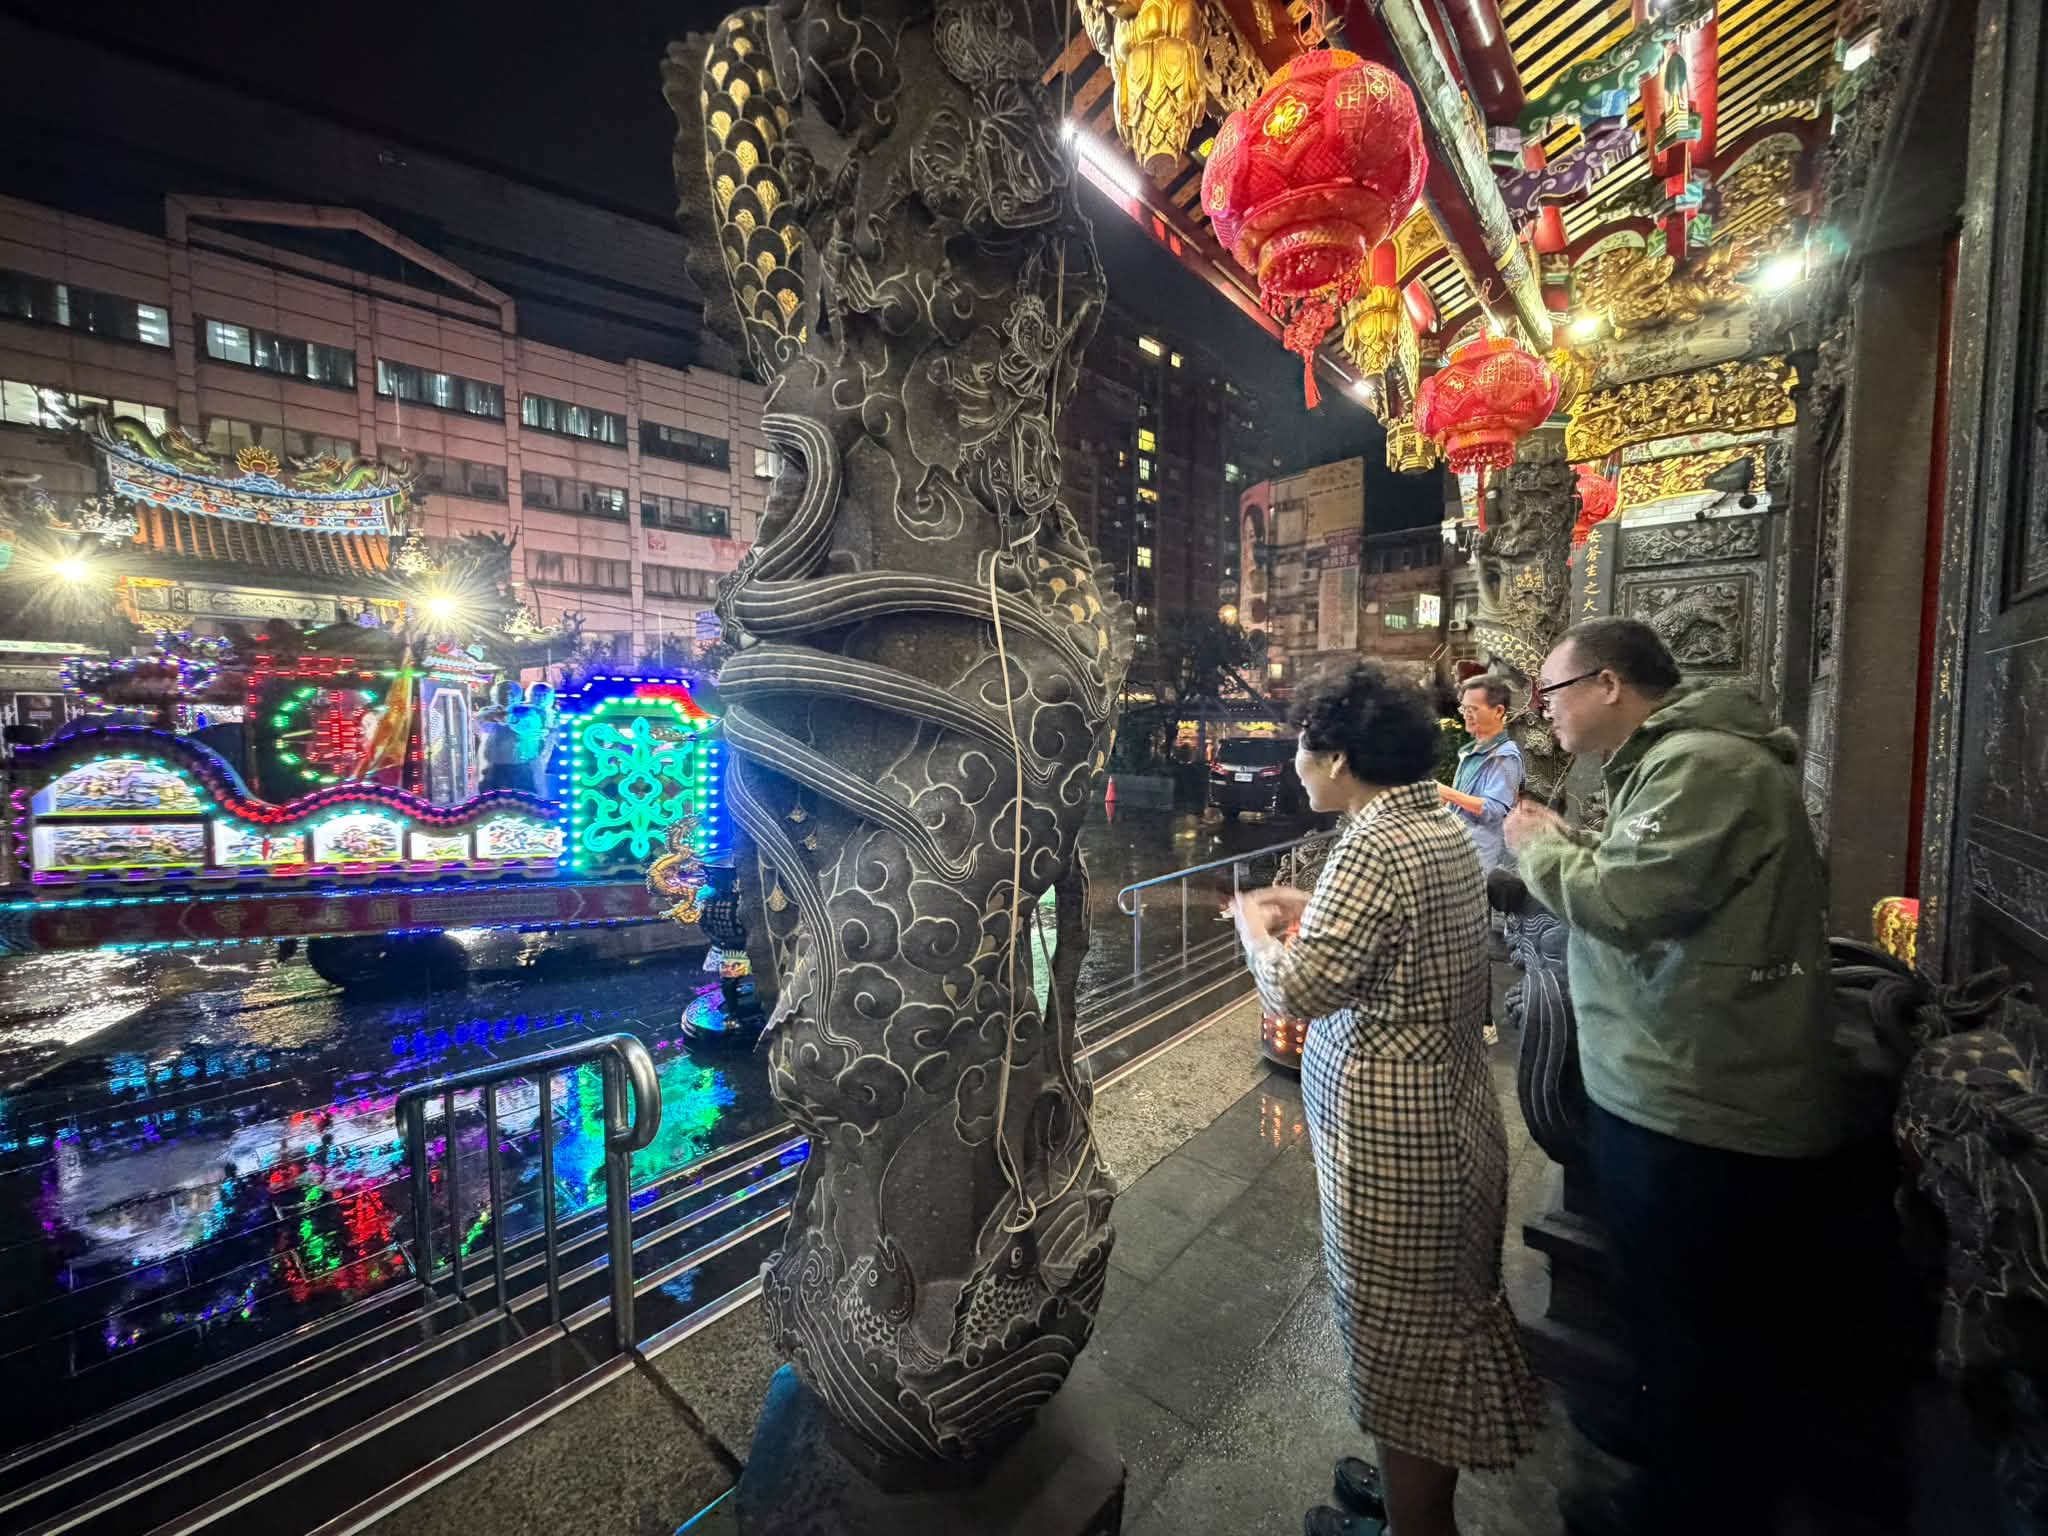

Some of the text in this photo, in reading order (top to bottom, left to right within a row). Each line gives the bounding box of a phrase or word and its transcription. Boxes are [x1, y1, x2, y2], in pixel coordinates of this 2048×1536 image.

[1581, 528, 1603, 621] 安蒼生之大
